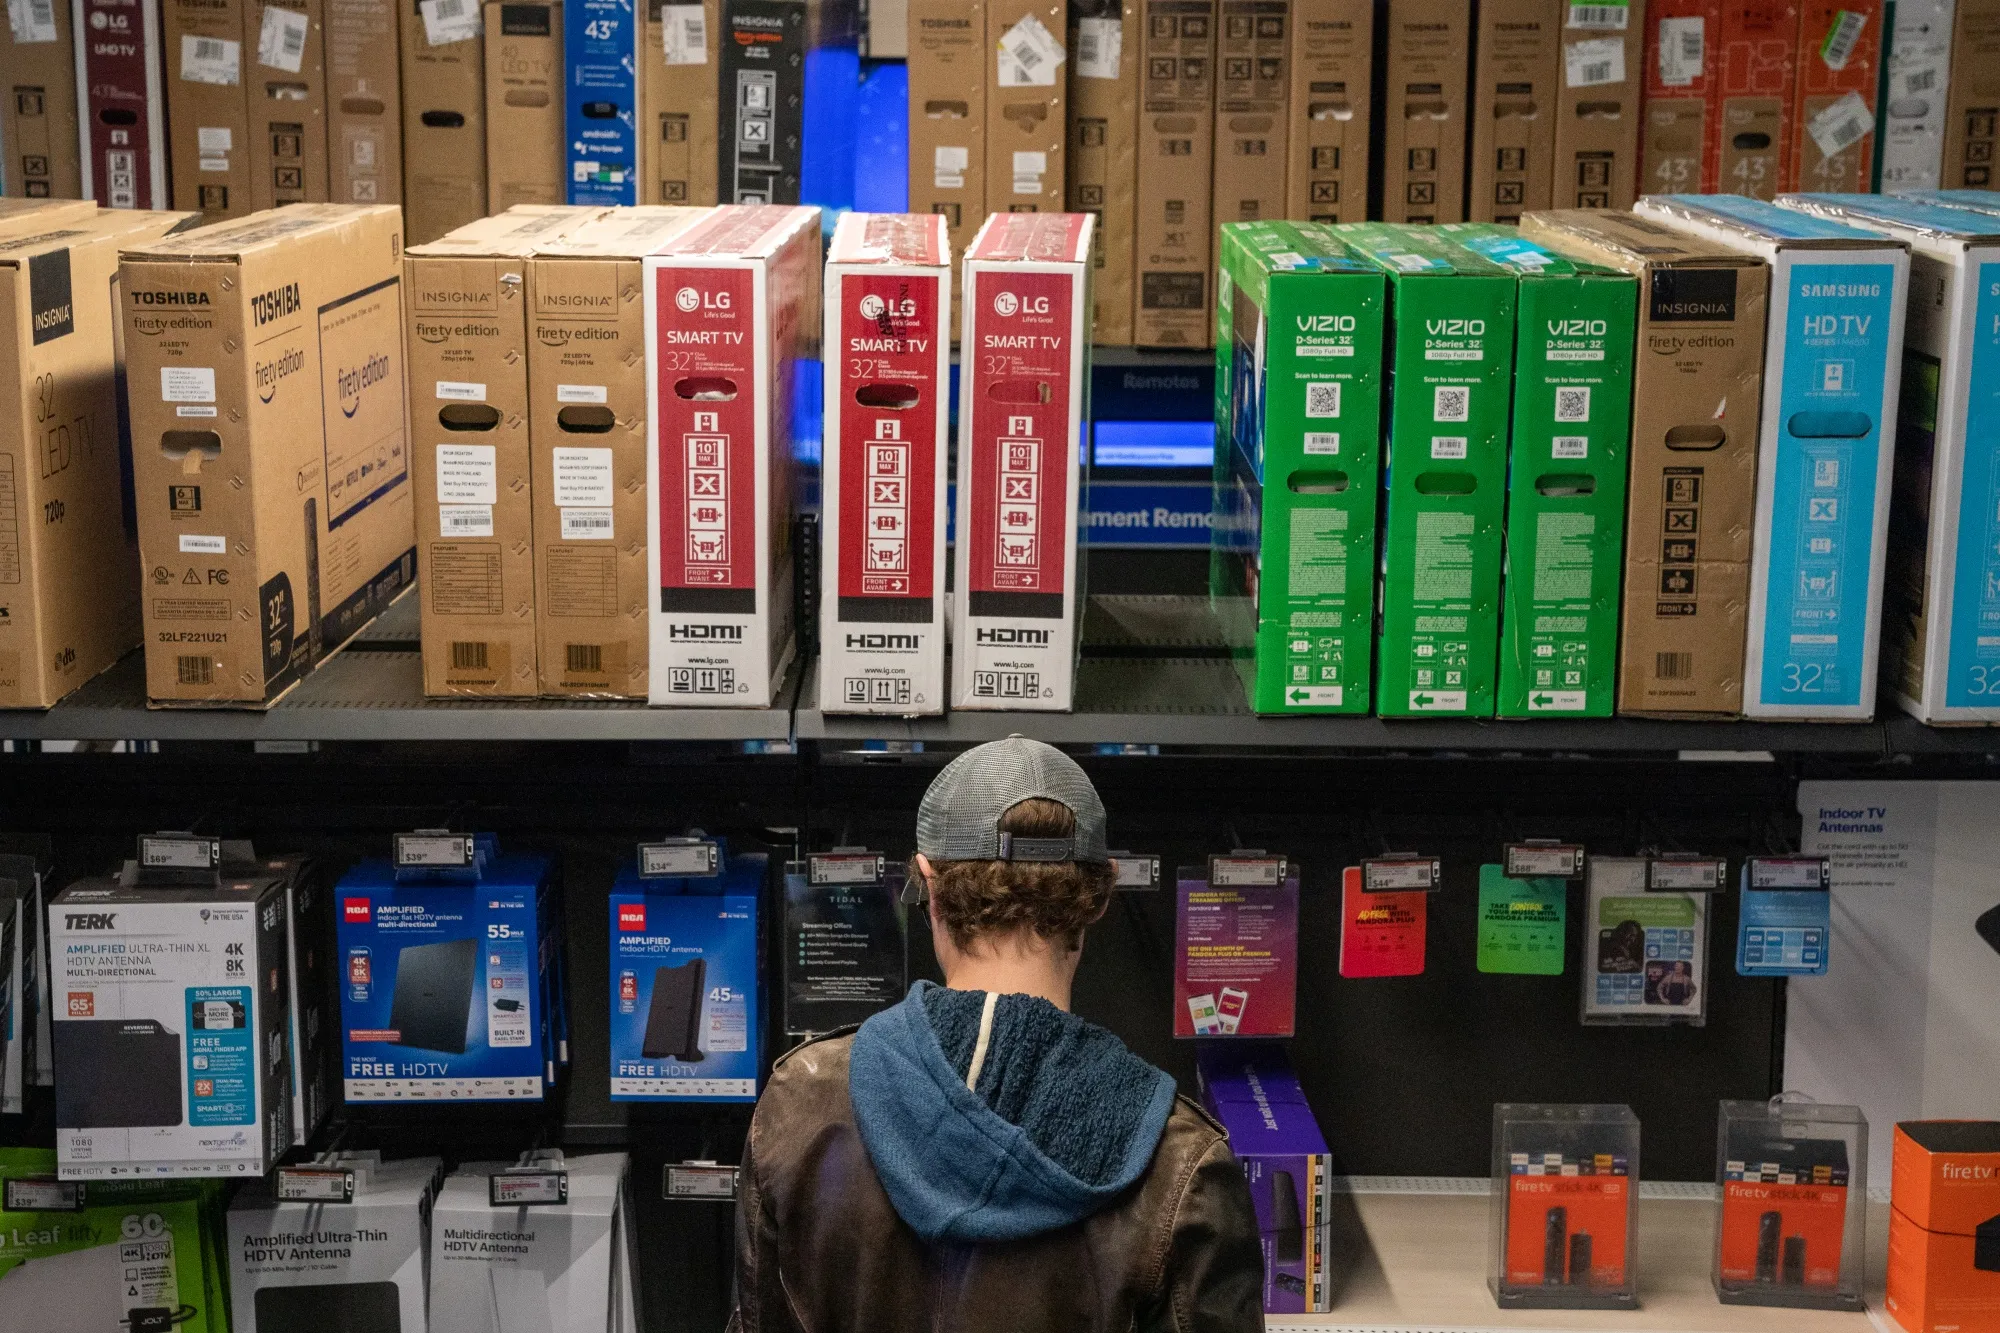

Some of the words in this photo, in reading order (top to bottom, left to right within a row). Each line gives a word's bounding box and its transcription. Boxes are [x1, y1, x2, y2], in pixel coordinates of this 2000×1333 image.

[109, 14, 128, 28] LG
[732, 16, 783, 27] INSIGNIA
[921, 19, 970, 28] TOSHIBA
[1802, 284, 1880, 297] SAMSUNG
[132, 292, 210, 305] TOSHIBA
[252, 282, 301, 327] TOSHIBA
[422, 293, 489, 303] INSIGNIA
[544, 296, 610, 306] INSIGNIA
[704, 292, 730, 308] LG
[890, 299, 915, 316] LG
[1023, 297, 1048, 313] LG
[1658, 303, 1726, 314] INSIGNIA
[35, 310, 70, 331] INSIGNIA
[170, 318, 212, 328] edition
[1297, 316, 1355, 331] VIZIO
[1426, 320, 1485, 335] VIZIO
[1548, 320, 1606, 336] VIZIO
[667, 331, 719, 344] SMART
[724, 332, 743, 344] TV
[985, 335, 1034, 348] SMART
[1041, 337, 1061, 349] TV
[851, 339, 901, 351] SMART
[908, 340, 927, 352] TV
[1124, 374, 1199, 389] Remotes
[36, 372, 55, 423] 32
[40, 423, 72, 479] LED
[698, 444, 711, 453] 10
[178, 489, 184, 498] 6
[45, 500, 65, 525] 720p
[1658, 604, 1682, 613] FRONT
[159, 633, 227, 642] 32LF221U21
[670, 625, 742, 638] HDMI
[977, 628, 1048, 643] HDMI
[846, 634, 918, 648] HDMI
[1820, 808, 1864, 818] Indoor
[1867, 808, 1886, 818] TV
[1819, 822, 1883, 832] Antennas
[65, 914, 117, 930] TERK
[488, 924, 510, 938] 55
[620, 937, 671, 945] AMPLIFIED
[67, 945, 126, 954] AMPLIFIED
[128, 944, 195, 953] ULTRA-THIN
[198, 944, 210, 952] XL
[225, 943, 244, 956] 4K
[68, 956, 96, 966] HDTV
[99, 956, 152, 965] ANTENNA
[226, 960, 243, 971] 8K
[66, 968, 156, 977] MULTI-DIRECTIONAL
[193, 1038, 220, 1046] FREE
[351, 1064, 395, 1076] FREE
[402, 1064, 448, 1075] HDTV
[620, 1066, 654, 1075] FREE
[661, 1066, 698, 1076] HDTV
[197, 1083, 210, 1091] 2X
[121, 1213, 164, 1239] 60
[12, 1226, 60, 1247] Leaf
[244, 1233, 314, 1248] Amplified
[318, 1230, 388, 1243] Ultra-Thin
[444, 1230, 534, 1242] Multidirectional
[444, 1242, 476, 1252] HDTV
[480, 1243, 528, 1253] Antenna
[244, 1249, 286, 1262] HDTV
[290, 1248, 350, 1260] Antenna
